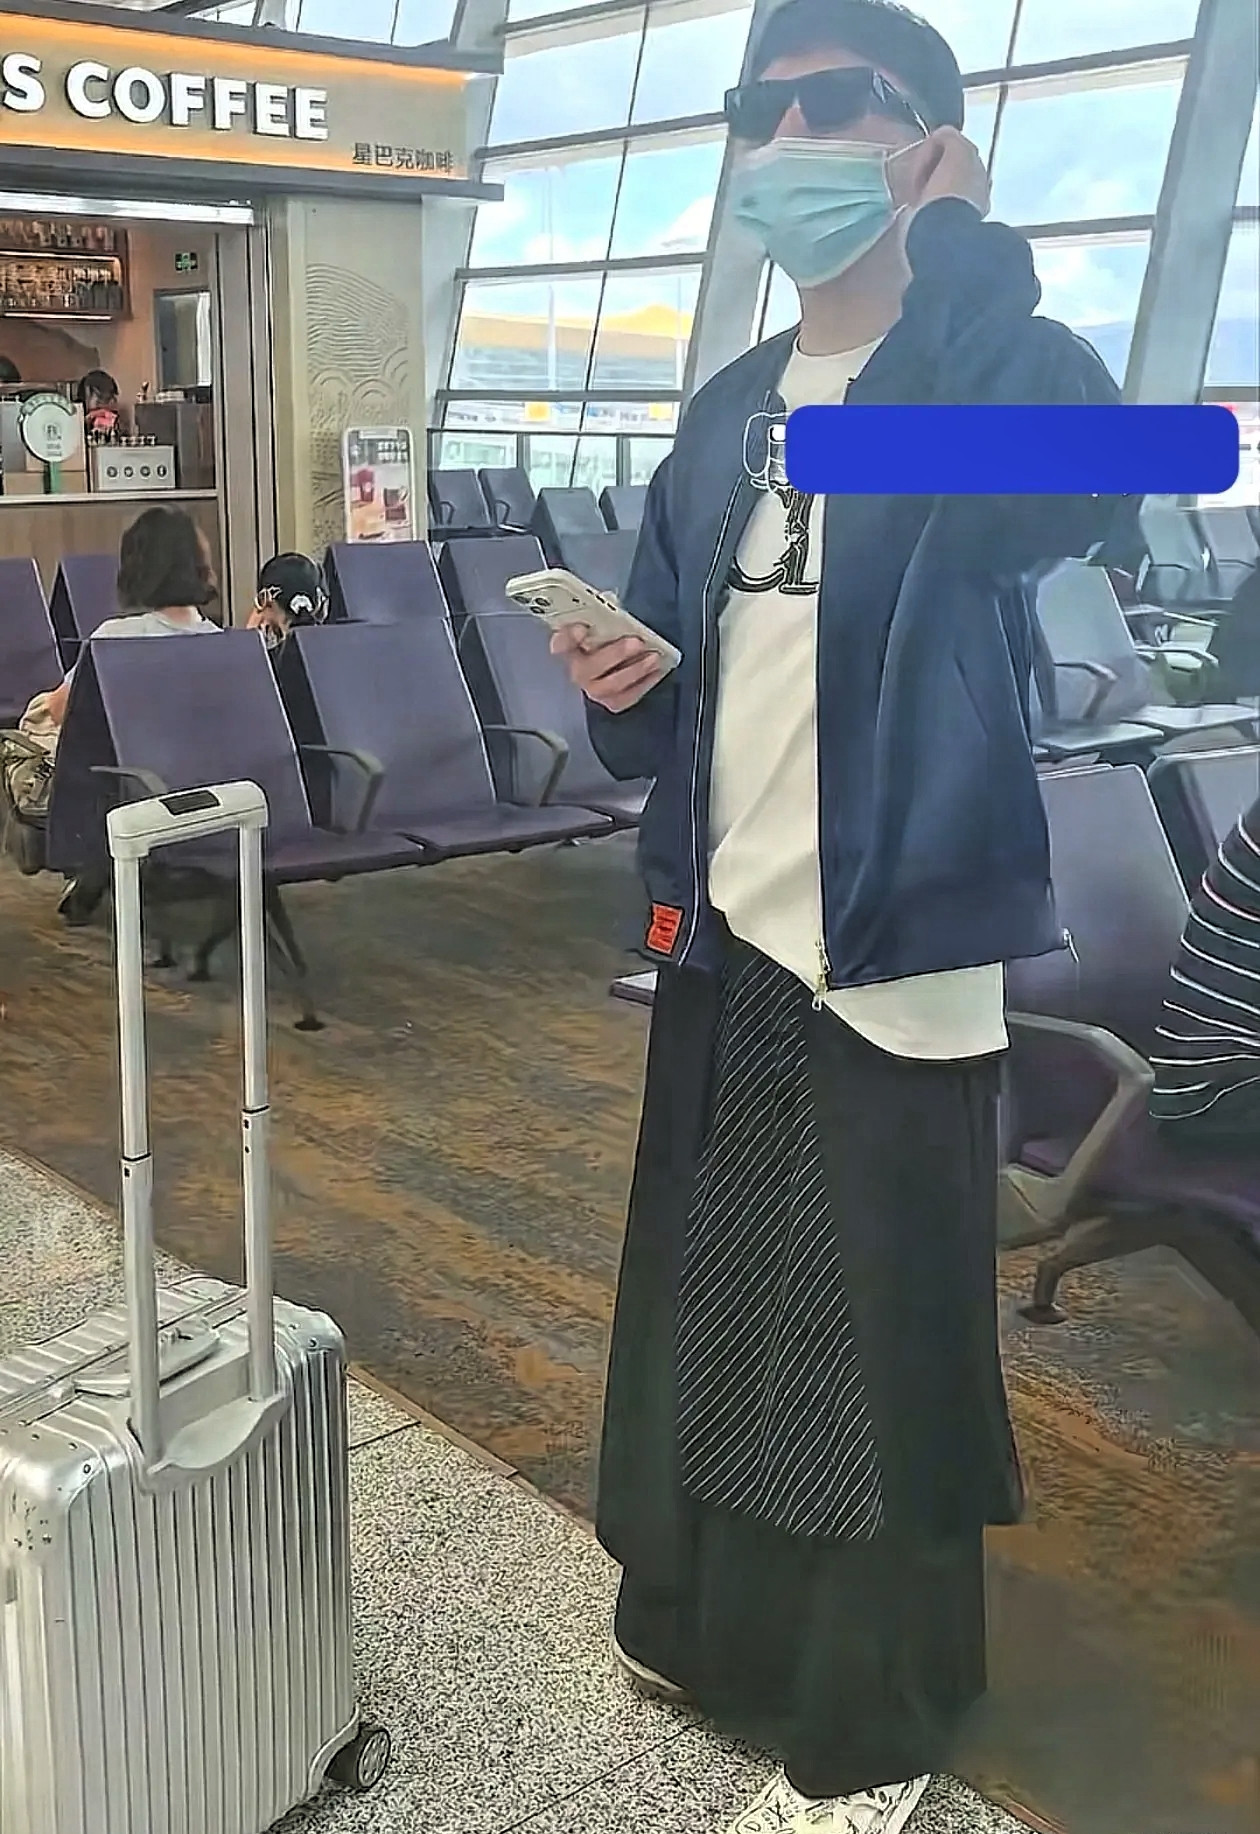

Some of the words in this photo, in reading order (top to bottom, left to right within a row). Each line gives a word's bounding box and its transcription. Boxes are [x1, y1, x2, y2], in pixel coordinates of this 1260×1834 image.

[65, 59, 329, 141] COFFEE
[351, 141, 454, 173] 星巴克咖啡
